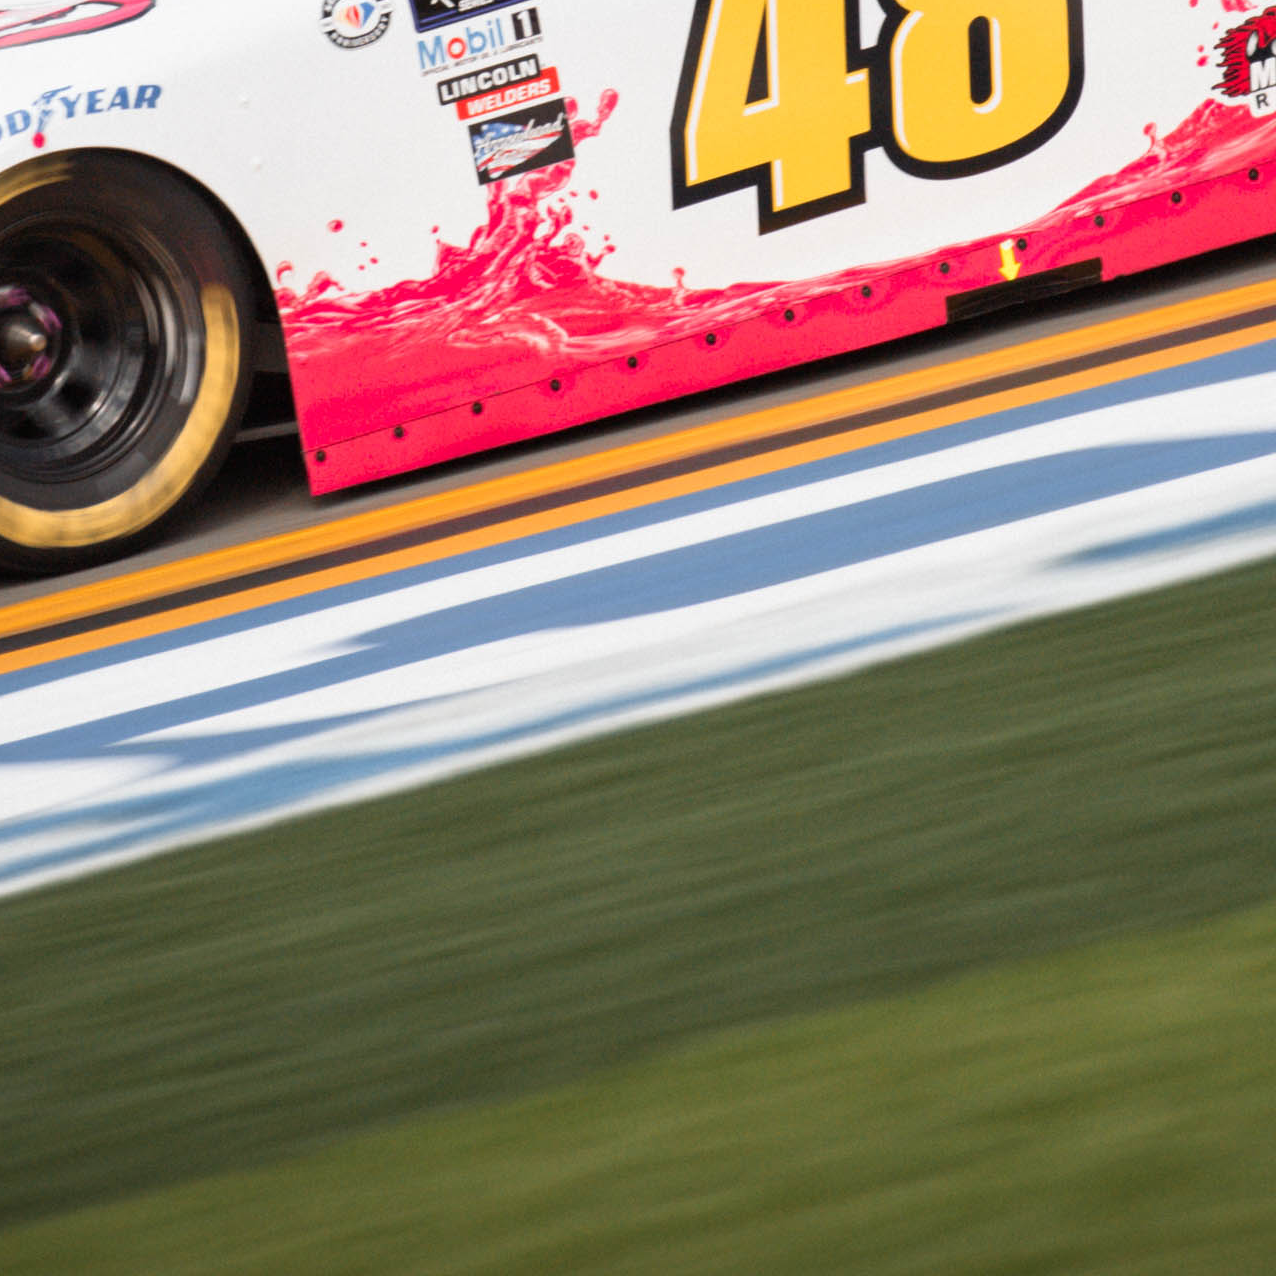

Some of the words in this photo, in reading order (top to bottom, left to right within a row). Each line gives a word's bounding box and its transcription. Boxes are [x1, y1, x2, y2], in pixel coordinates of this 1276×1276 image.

[417, 17, 505, 70] Mobil
[515, 9, 536, 39] 1
[440, 58, 538, 102] LINCOLN
[467, 78, 551, 115] WELDERS
